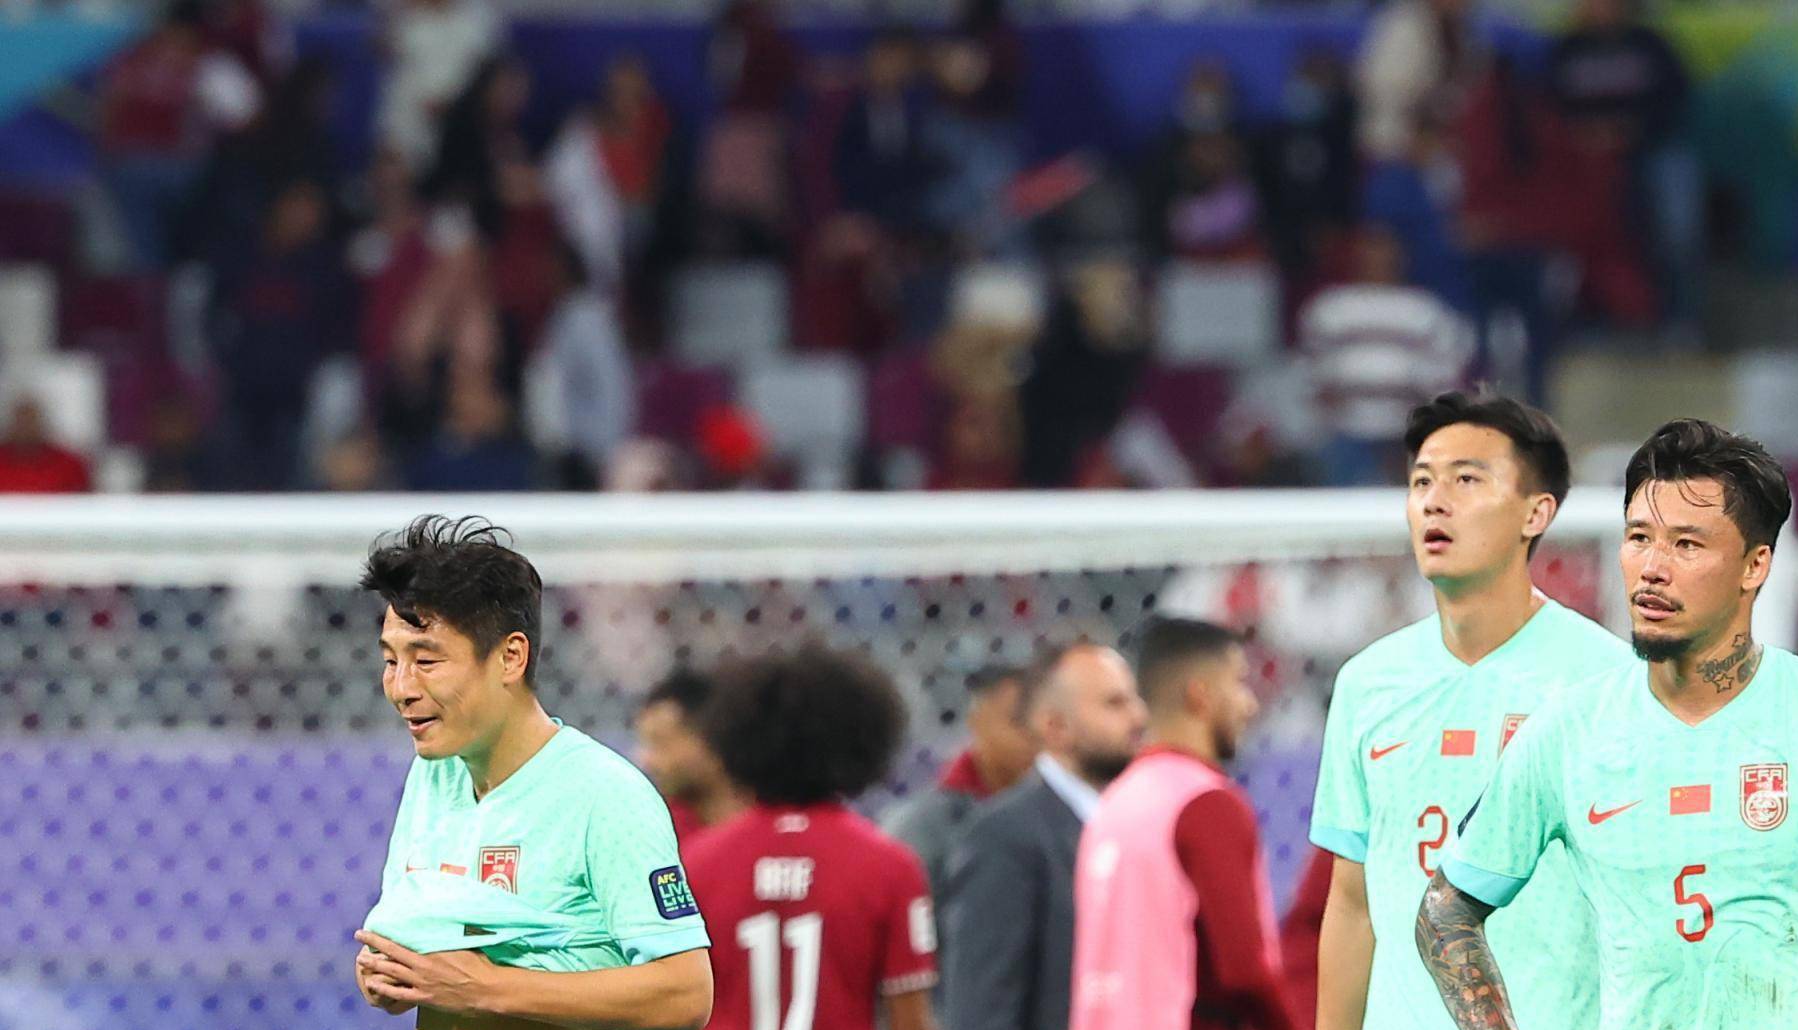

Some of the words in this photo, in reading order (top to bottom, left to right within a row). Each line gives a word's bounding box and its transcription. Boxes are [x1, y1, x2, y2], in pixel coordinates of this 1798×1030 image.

[483, 851, 516, 865] CFA
[657, 872, 677, 886] AFC
[1673, 864, 1714, 943] 5
